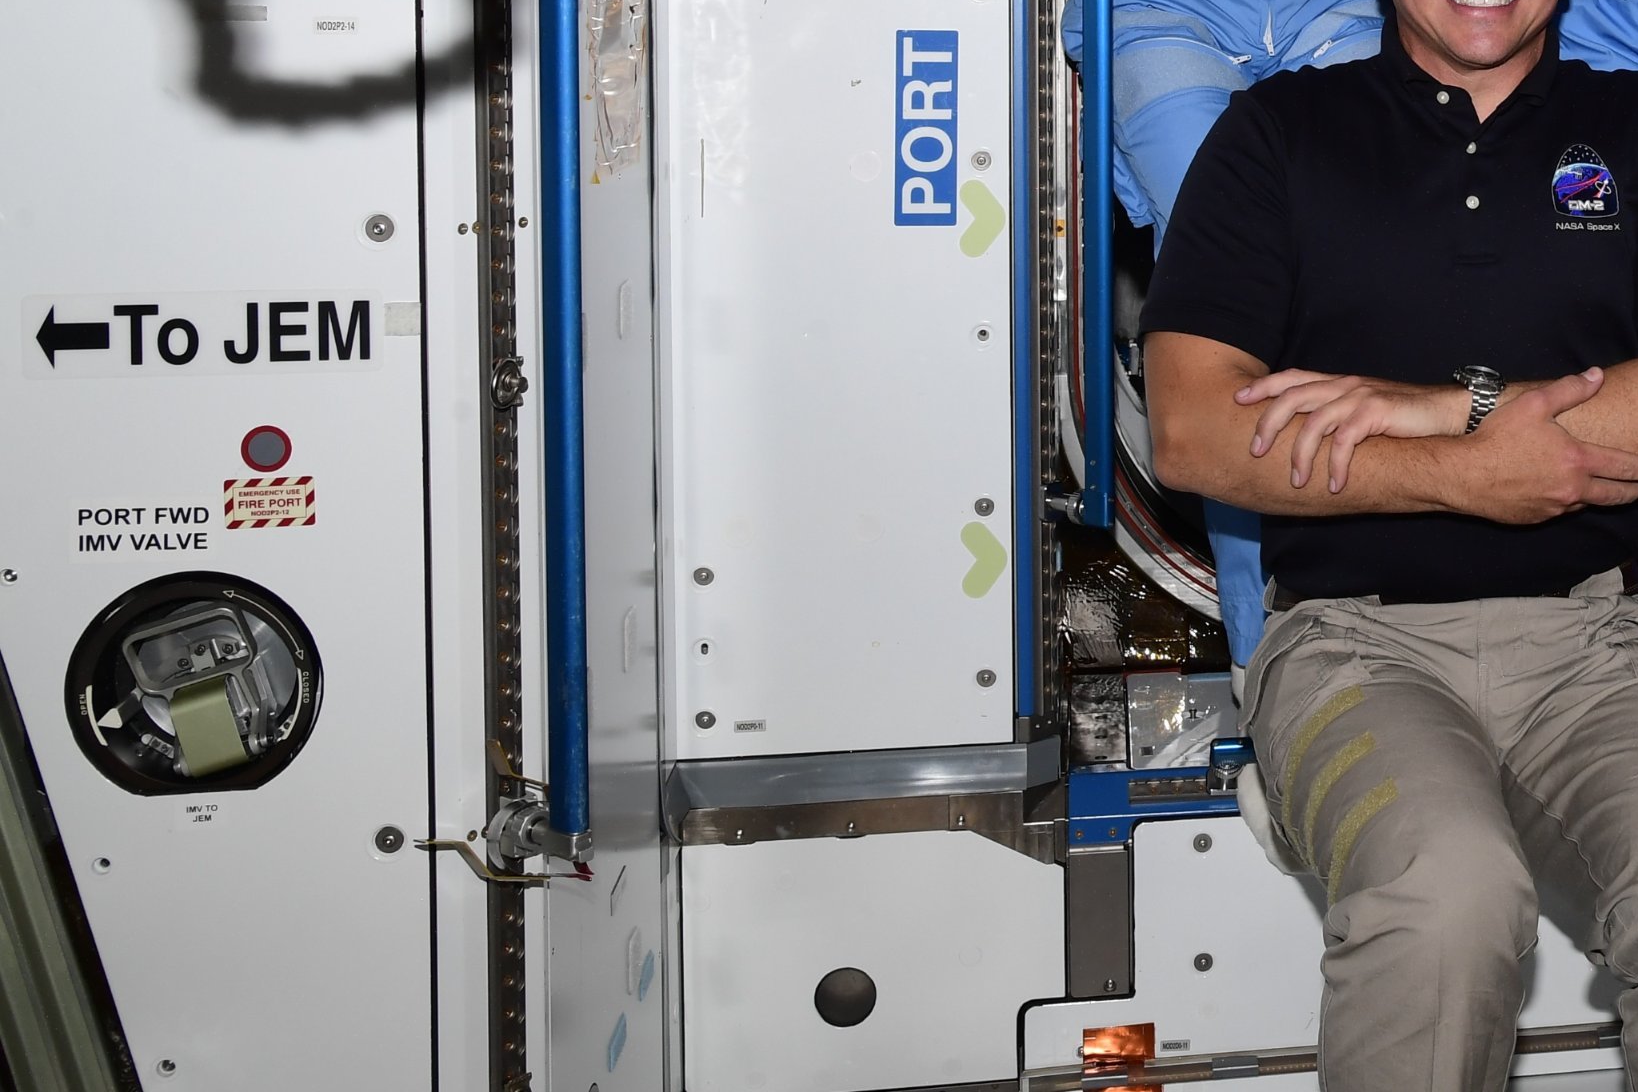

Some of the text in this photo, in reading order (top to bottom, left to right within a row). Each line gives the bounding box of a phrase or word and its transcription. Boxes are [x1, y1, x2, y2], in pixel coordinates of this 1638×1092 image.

[316, 21, 355, 31] NOD2P2-14
[901, 36, 953, 216] PORT
[1555, 222, 1585, 230] NASA
[113, 299, 372, 367] To JEM
[238, 488, 301, 498] EMERGENCY USE
[238, 496, 303, 510] FIRE PORT
[78, 506, 210, 527] PORT FWD
[250, 509, 291, 518] NOD2P2-12
[78, 531, 208, 553] IMV VALVE
[302, 671, 310, 705] CLOSED
[80, 693, 88, 716] OPEN
[185, 804, 219, 814] IMV TO
[192, 814, 213, 823] JEM
